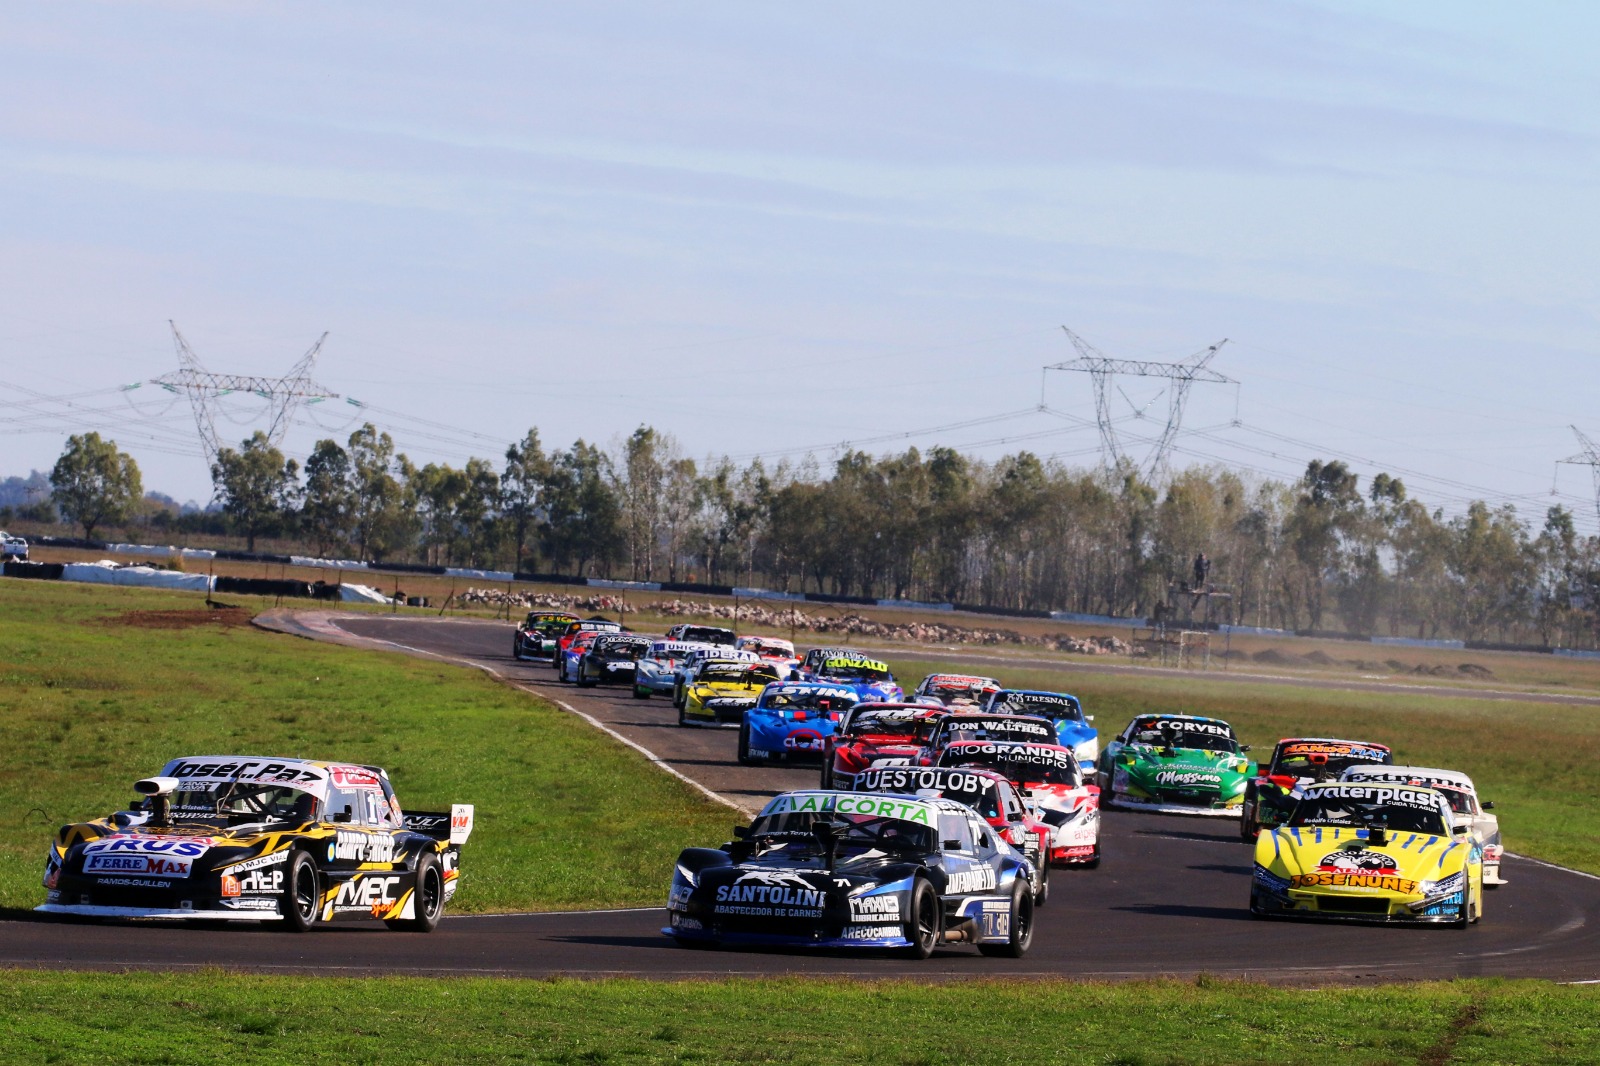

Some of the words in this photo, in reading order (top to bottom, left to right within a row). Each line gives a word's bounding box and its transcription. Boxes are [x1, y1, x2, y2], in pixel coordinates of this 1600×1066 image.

[826, 658, 889, 673] GONZALO
[1025, 695, 1071, 707] TRESNAL
[948, 722, 979, 732] DON
[981, 720, 1049, 736] WALTHER
[1156, 720, 1230, 738] CORVEN
[997, 754, 1067, 769] MUNICIPIO
[1303, 786, 1440, 808] waterplast
[1419, 805, 1437, 813] AGUA
[246, 858, 268, 868] MJC
[1333, 867, 1381, 876] ALSINA
[97, 878, 171, 888] RAMOS-GUILLEN
[1290, 873, 1346, 889] JOSE
[335, 876, 400, 905] MEC
[716, 885, 827, 909] SANTOLINI
[714, 905, 772, 916] ABASTECEDOR
[775, 908, 786, 916] DE
[788, 909, 823, 918] CARNES
